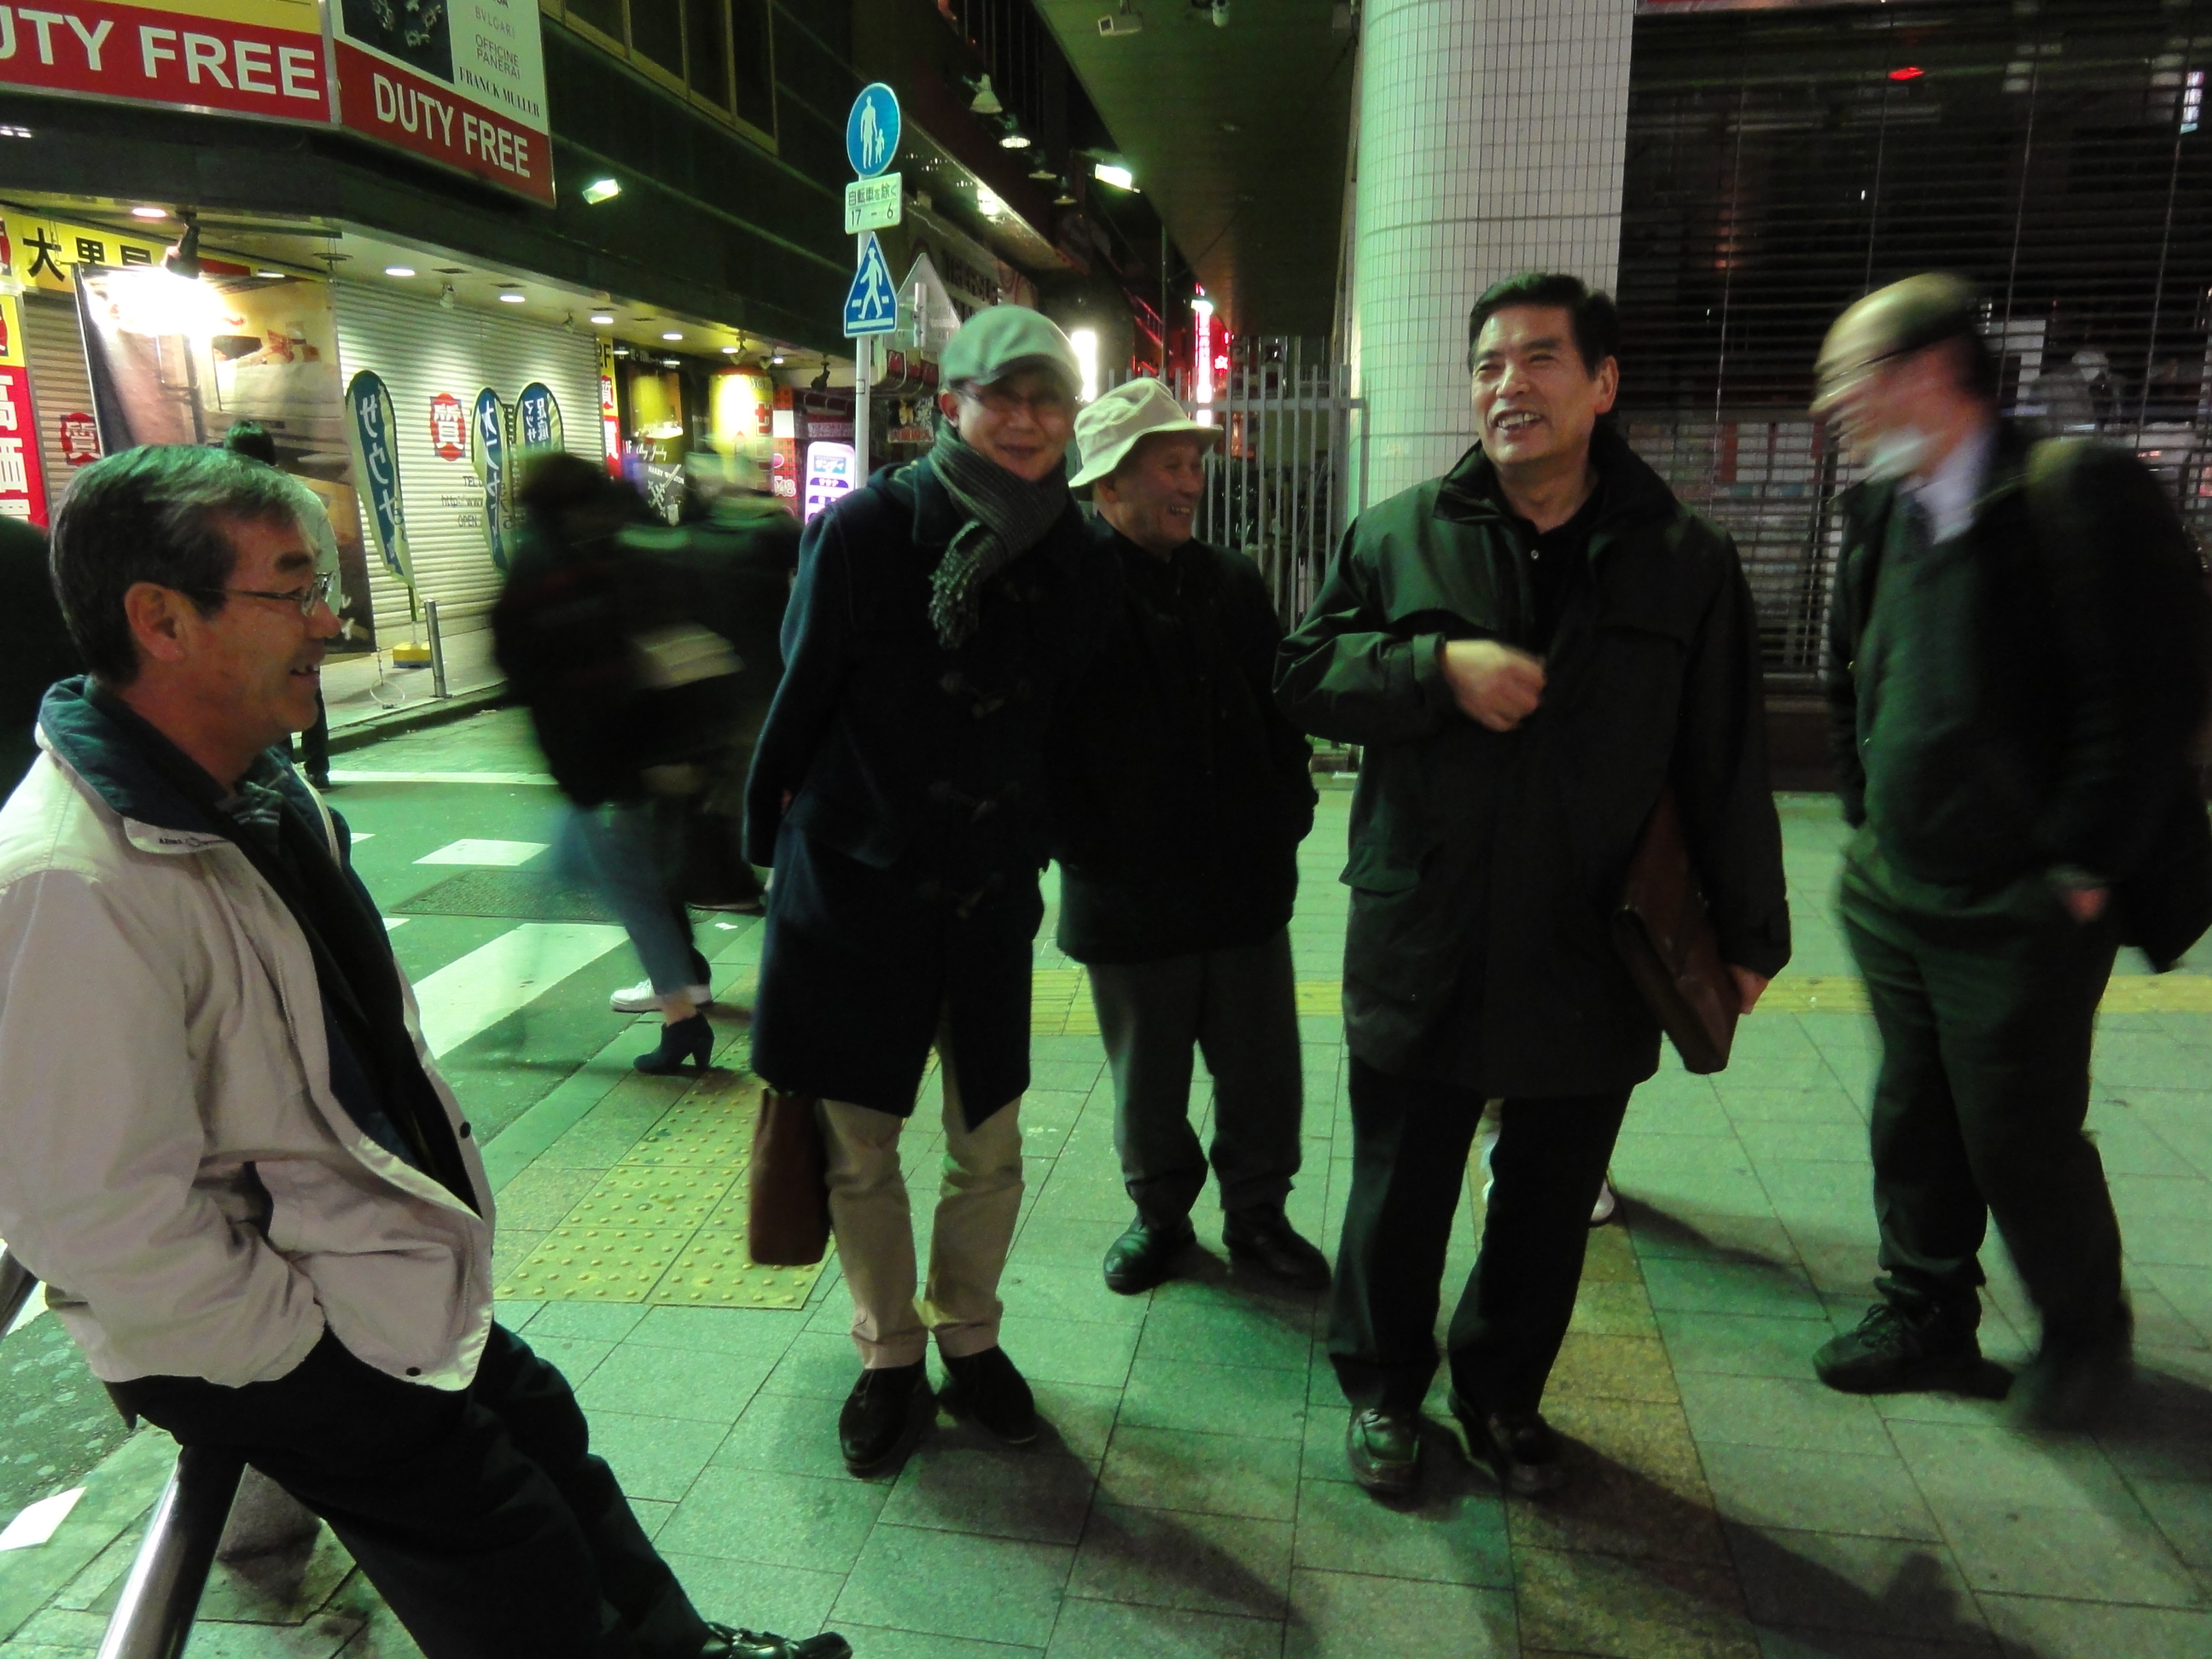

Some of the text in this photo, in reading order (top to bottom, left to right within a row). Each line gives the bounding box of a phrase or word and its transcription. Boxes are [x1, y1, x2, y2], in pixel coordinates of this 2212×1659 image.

[474, 5, 515, 39] BVLGARI
[138, 25, 320, 101] FREE
[474, 34, 519, 68] OFFICINE
[476, 48, 521, 81] PANERAI
[459, 66, 540, 118] FRANCK MULLER
[374, 73, 531, 178] DUTY FREE
[848, 182, 897, 207] 自転車を除く
[851, 208, 862, 227] 17
[887, 201, 894, 219] 6
[457, 515, 477, 527] OPEN
